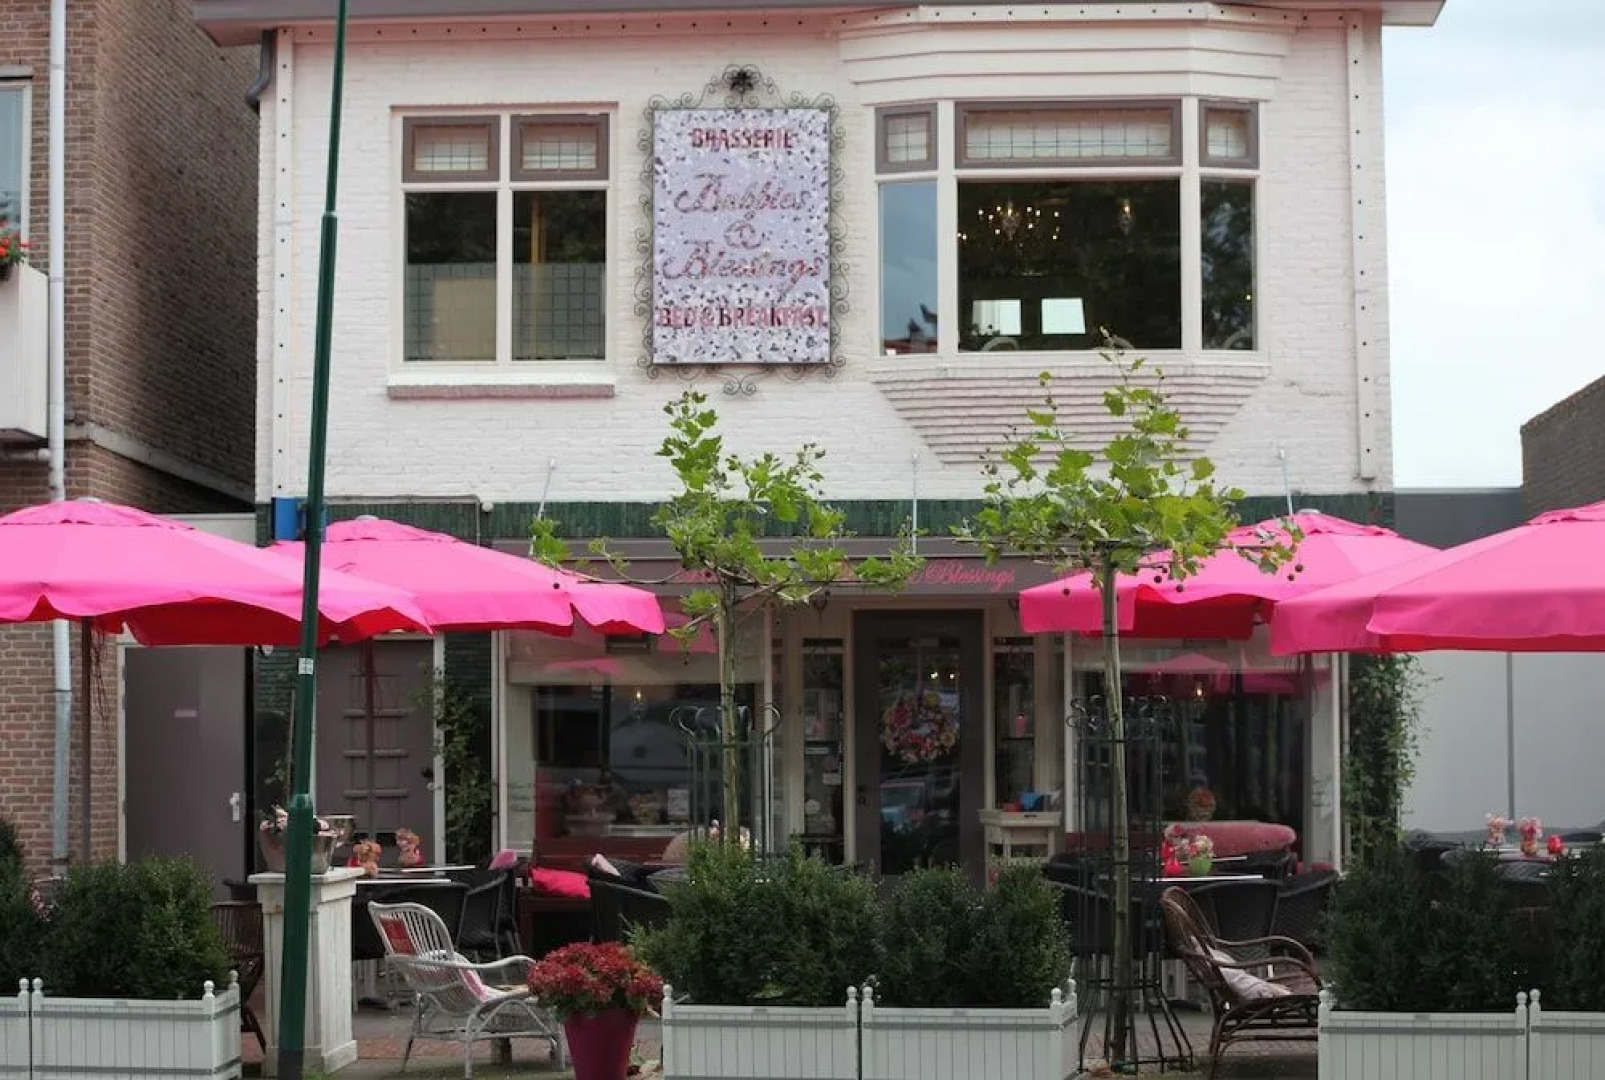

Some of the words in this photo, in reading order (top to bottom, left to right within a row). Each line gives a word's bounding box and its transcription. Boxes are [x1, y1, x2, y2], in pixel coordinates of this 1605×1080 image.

[691, 128, 794, 150] BRASSERIE
[663, 240, 824, 298] Blessings
[659, 307, 697, 329] BED
[718, 306, 828, 329] BREAKFAST
